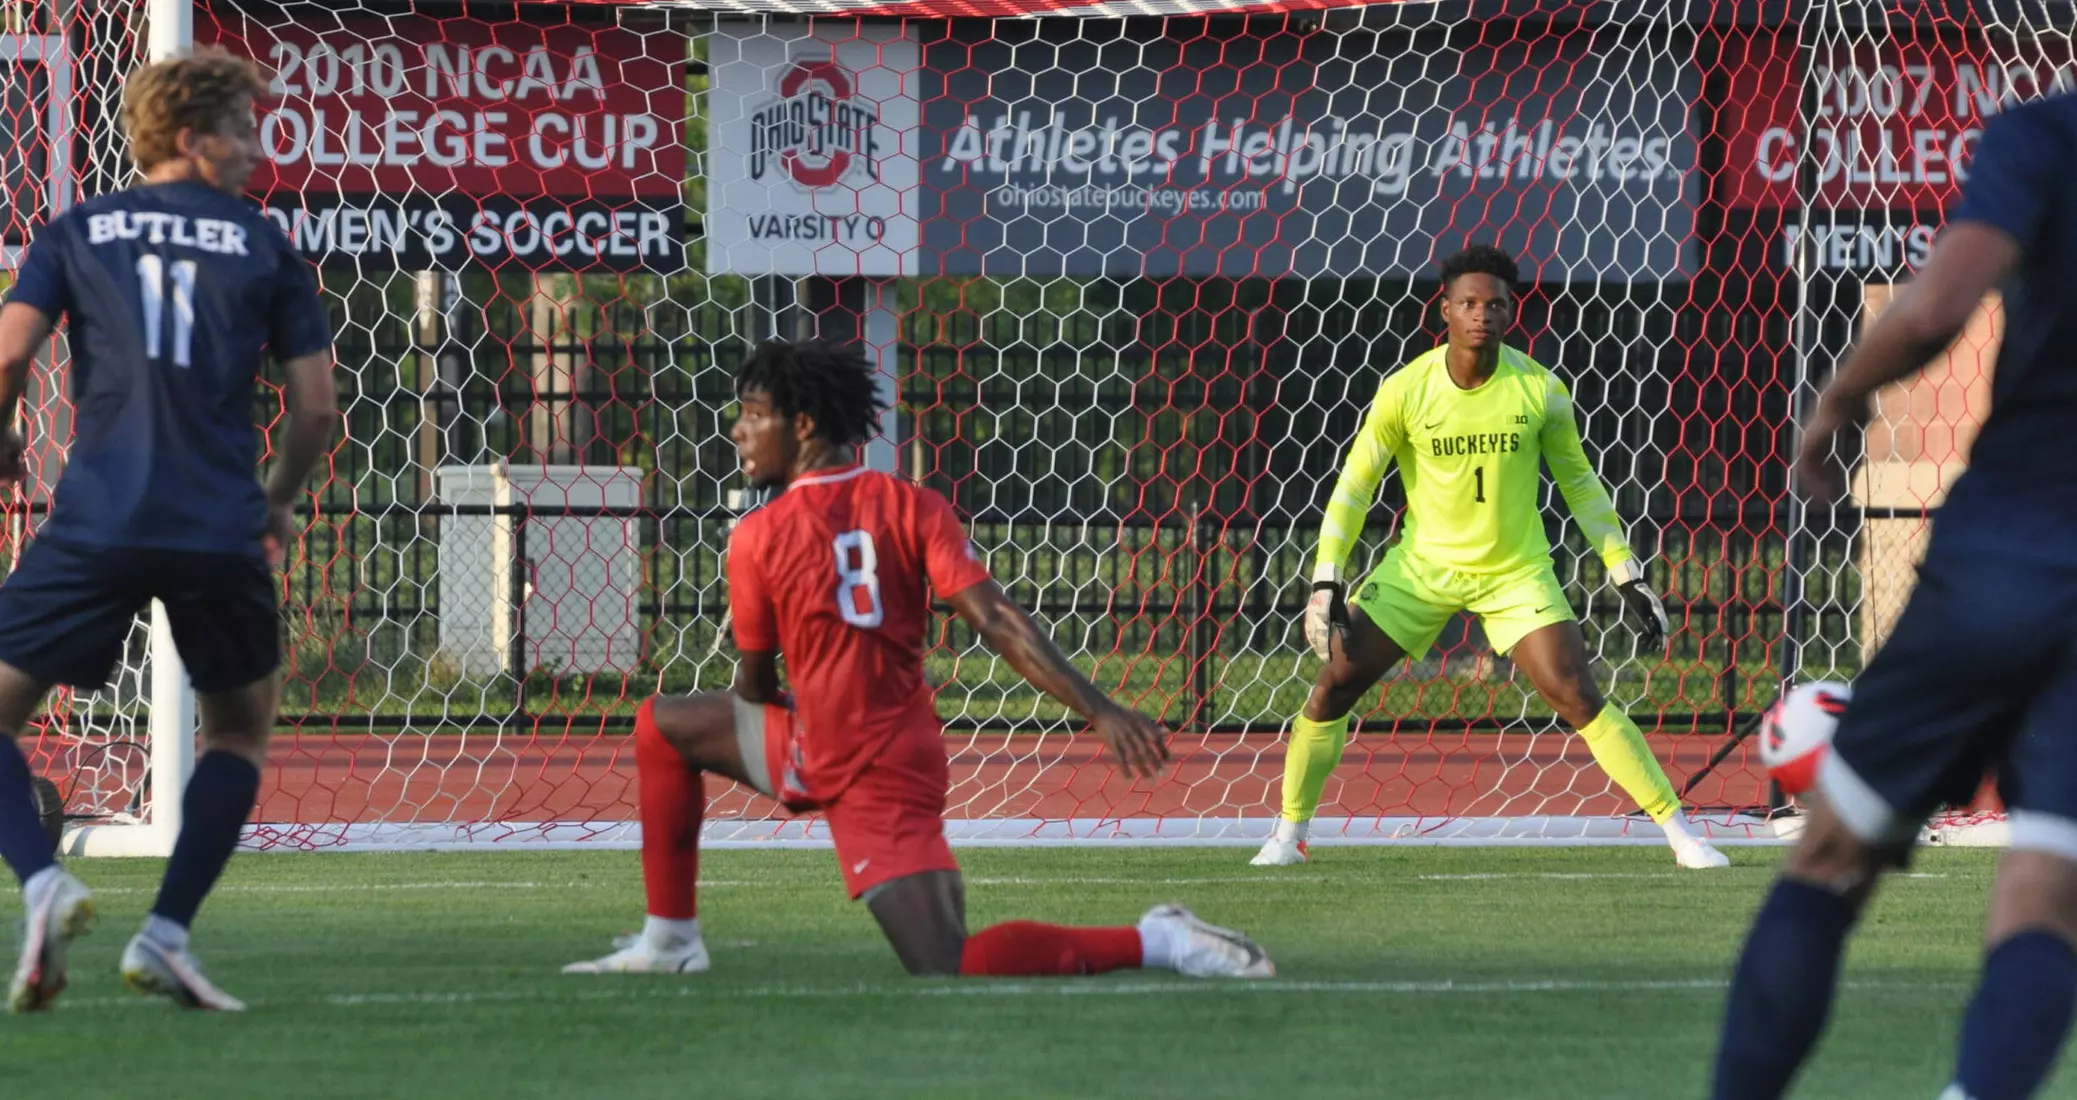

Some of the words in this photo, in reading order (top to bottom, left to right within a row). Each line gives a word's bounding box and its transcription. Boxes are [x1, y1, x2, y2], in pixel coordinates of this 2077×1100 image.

[268, 41, 404, 97] 2010
[426, 43, 606, 99] NCAA
[1815, 63, 1935, 118] 2007
[260, 108, 508, 167] OLLEGE
[529, 113, 658, 169] CUP
[942, 111, 1180, 175] Athletes
[1198, 112, 1417, 195] Helping
[1431, 117, 1669, 181] Athletes
[998, 184, 1267, 215] ohiostatebuckeyes.com
[87, 209, 250, 256] BUTLER
[470, 210, 670, 256] SOCCER
[749, 214, 860, 241] VARSITY
[865, 215, 886, 240] O
[135, 252, 198, 369] 11
[1431, 432, 1521, 457] BUCKEYES
[1474, 466, 1486, 503] 1
[832, 529, 884, 629] 8
